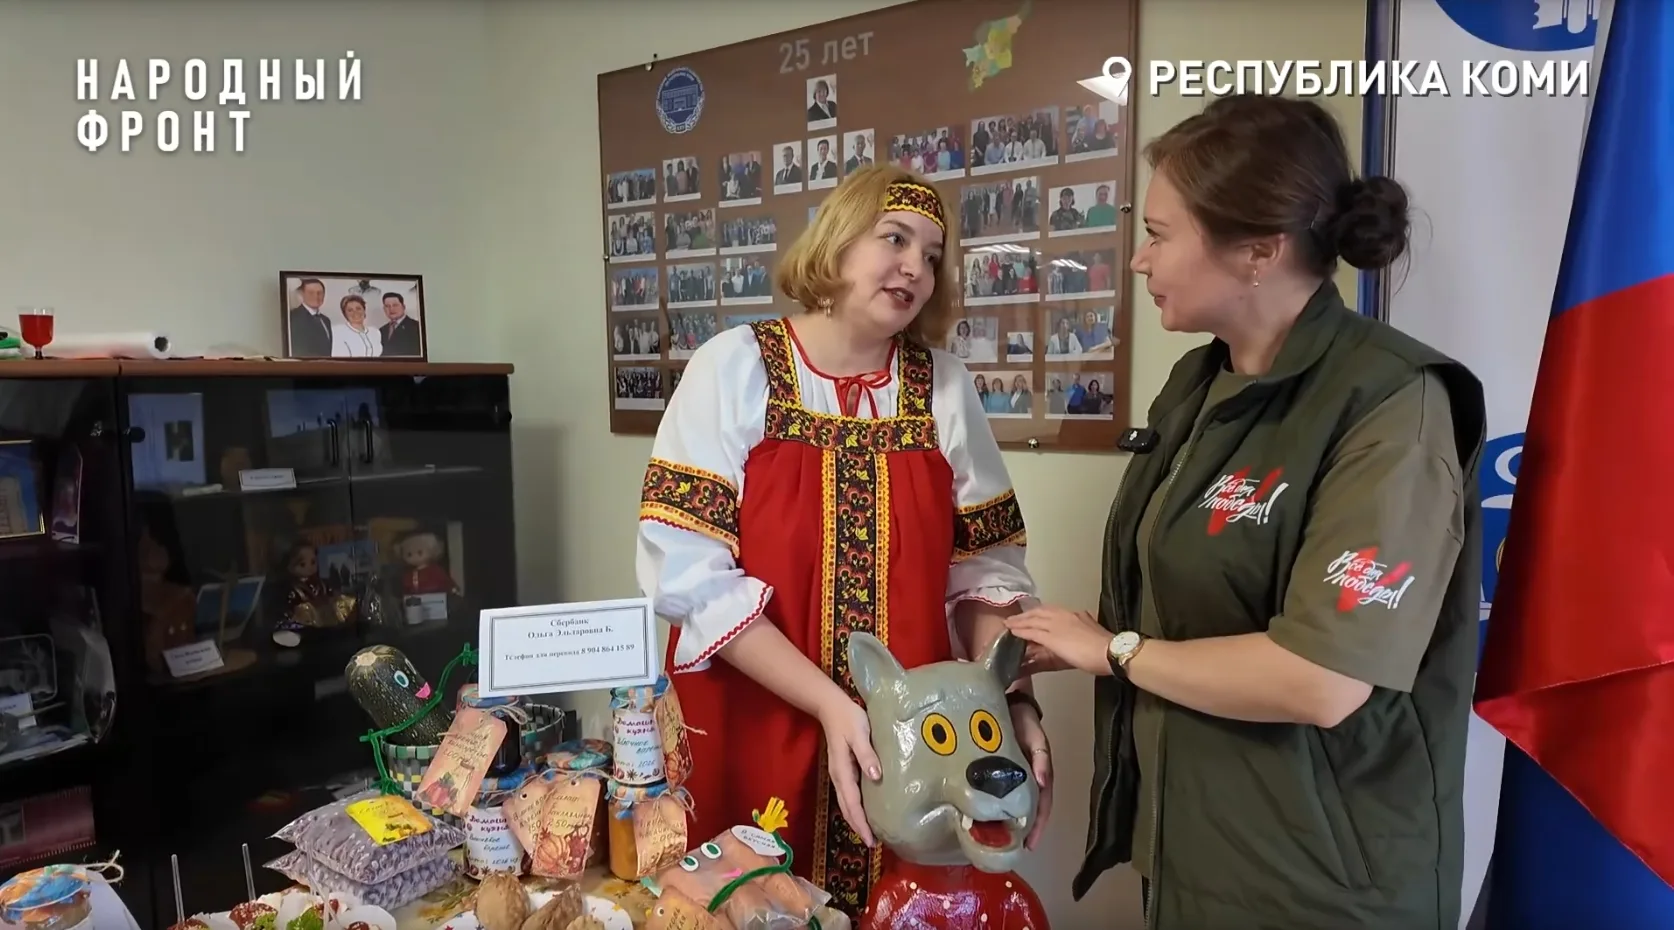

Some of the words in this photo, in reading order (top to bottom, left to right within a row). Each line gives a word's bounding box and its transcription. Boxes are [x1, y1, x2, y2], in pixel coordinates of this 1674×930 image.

[779, 39, 811, 74] 25
[822, 30, 875, 65] лет
[1198, 482, 1289, 525] победы!
[1323, 575, 1415, 609] победы!
[527, 629, 553, 640] Ольга
[550, 617, 590, 628] Сбербанк
[504, 652, 534, 662] Телефон
[549, 650, 580, 659] перевода
[587, 645, 600, 655] 904
[602, 644, 615, 653] 864
[616, 644, 625, 652] 15
[626, 643, 635, 651] 89
